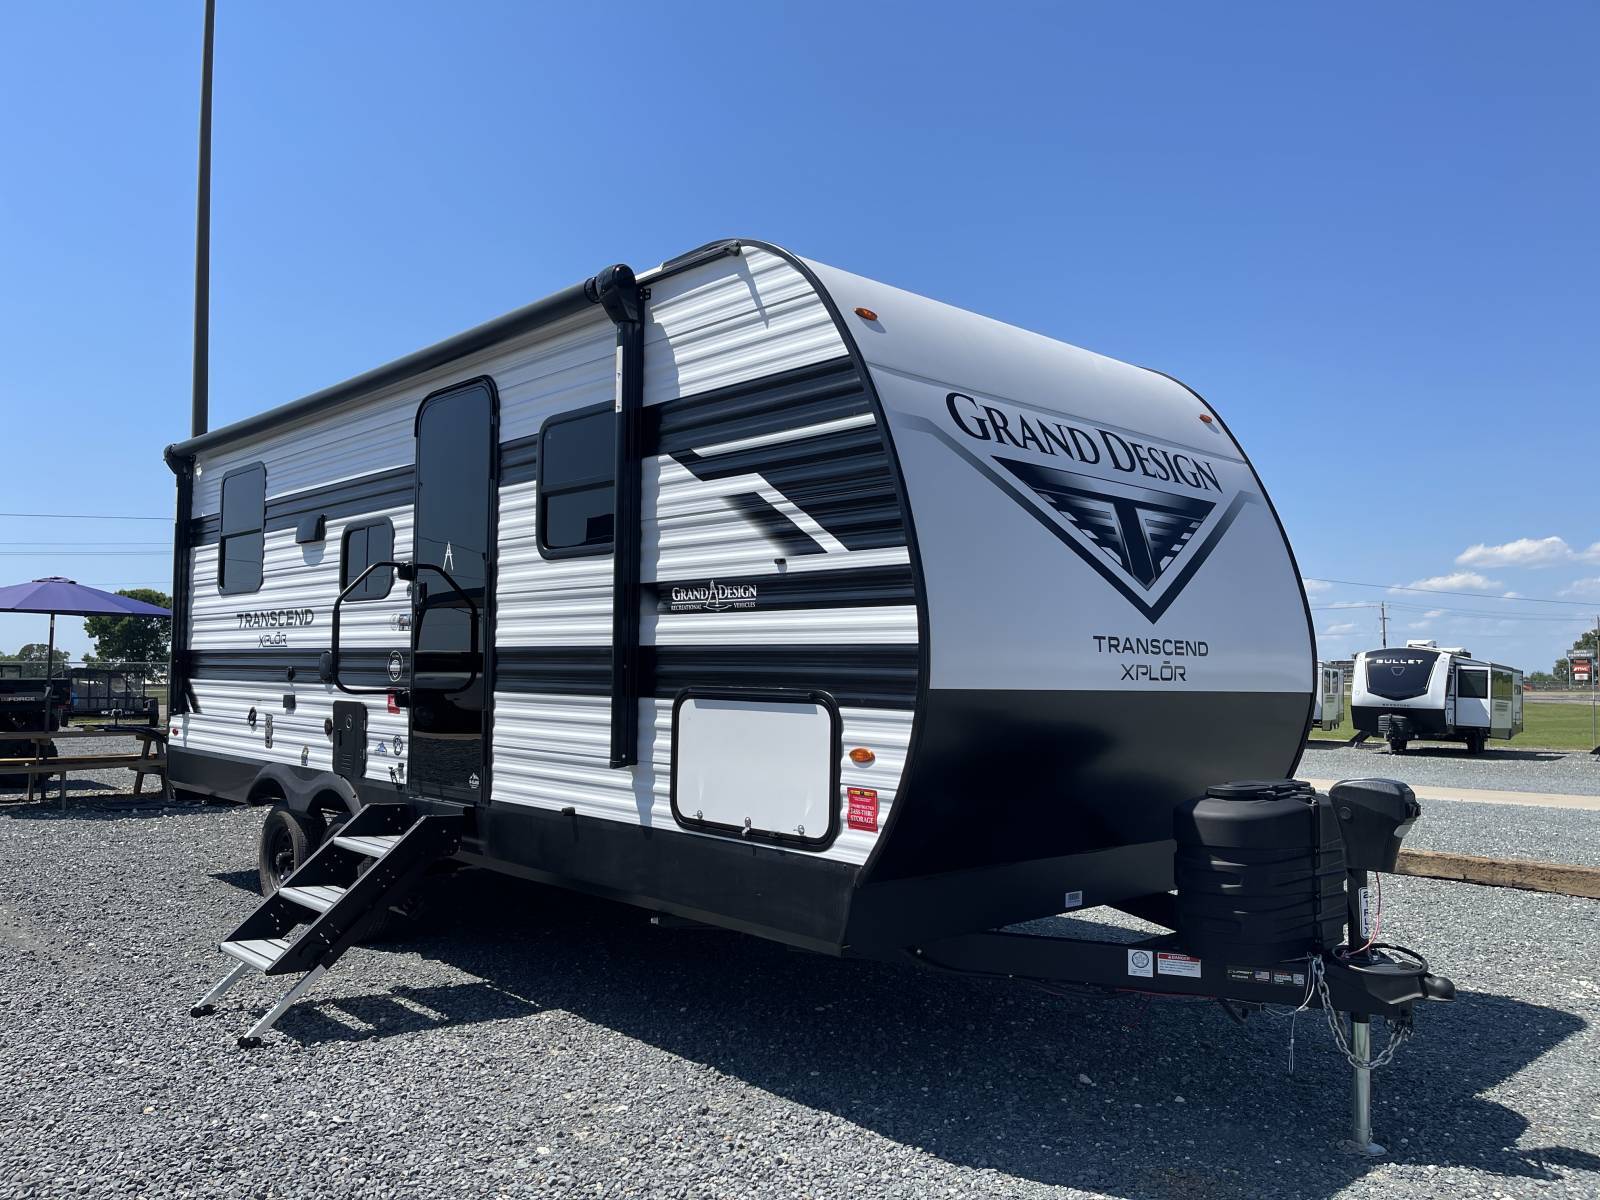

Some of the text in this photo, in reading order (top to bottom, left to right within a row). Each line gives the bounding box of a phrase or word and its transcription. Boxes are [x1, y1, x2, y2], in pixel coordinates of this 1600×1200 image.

[946, 392, 1223, 494] GRAND DESIGN
[671, 584, 757, 601] GRAND DESIGN
[236, 608, 315, 629] TRANSCEND
[1092, 635, 1209, 657] TRANSCEND
[850, 815, 875, 824] STORAGE
